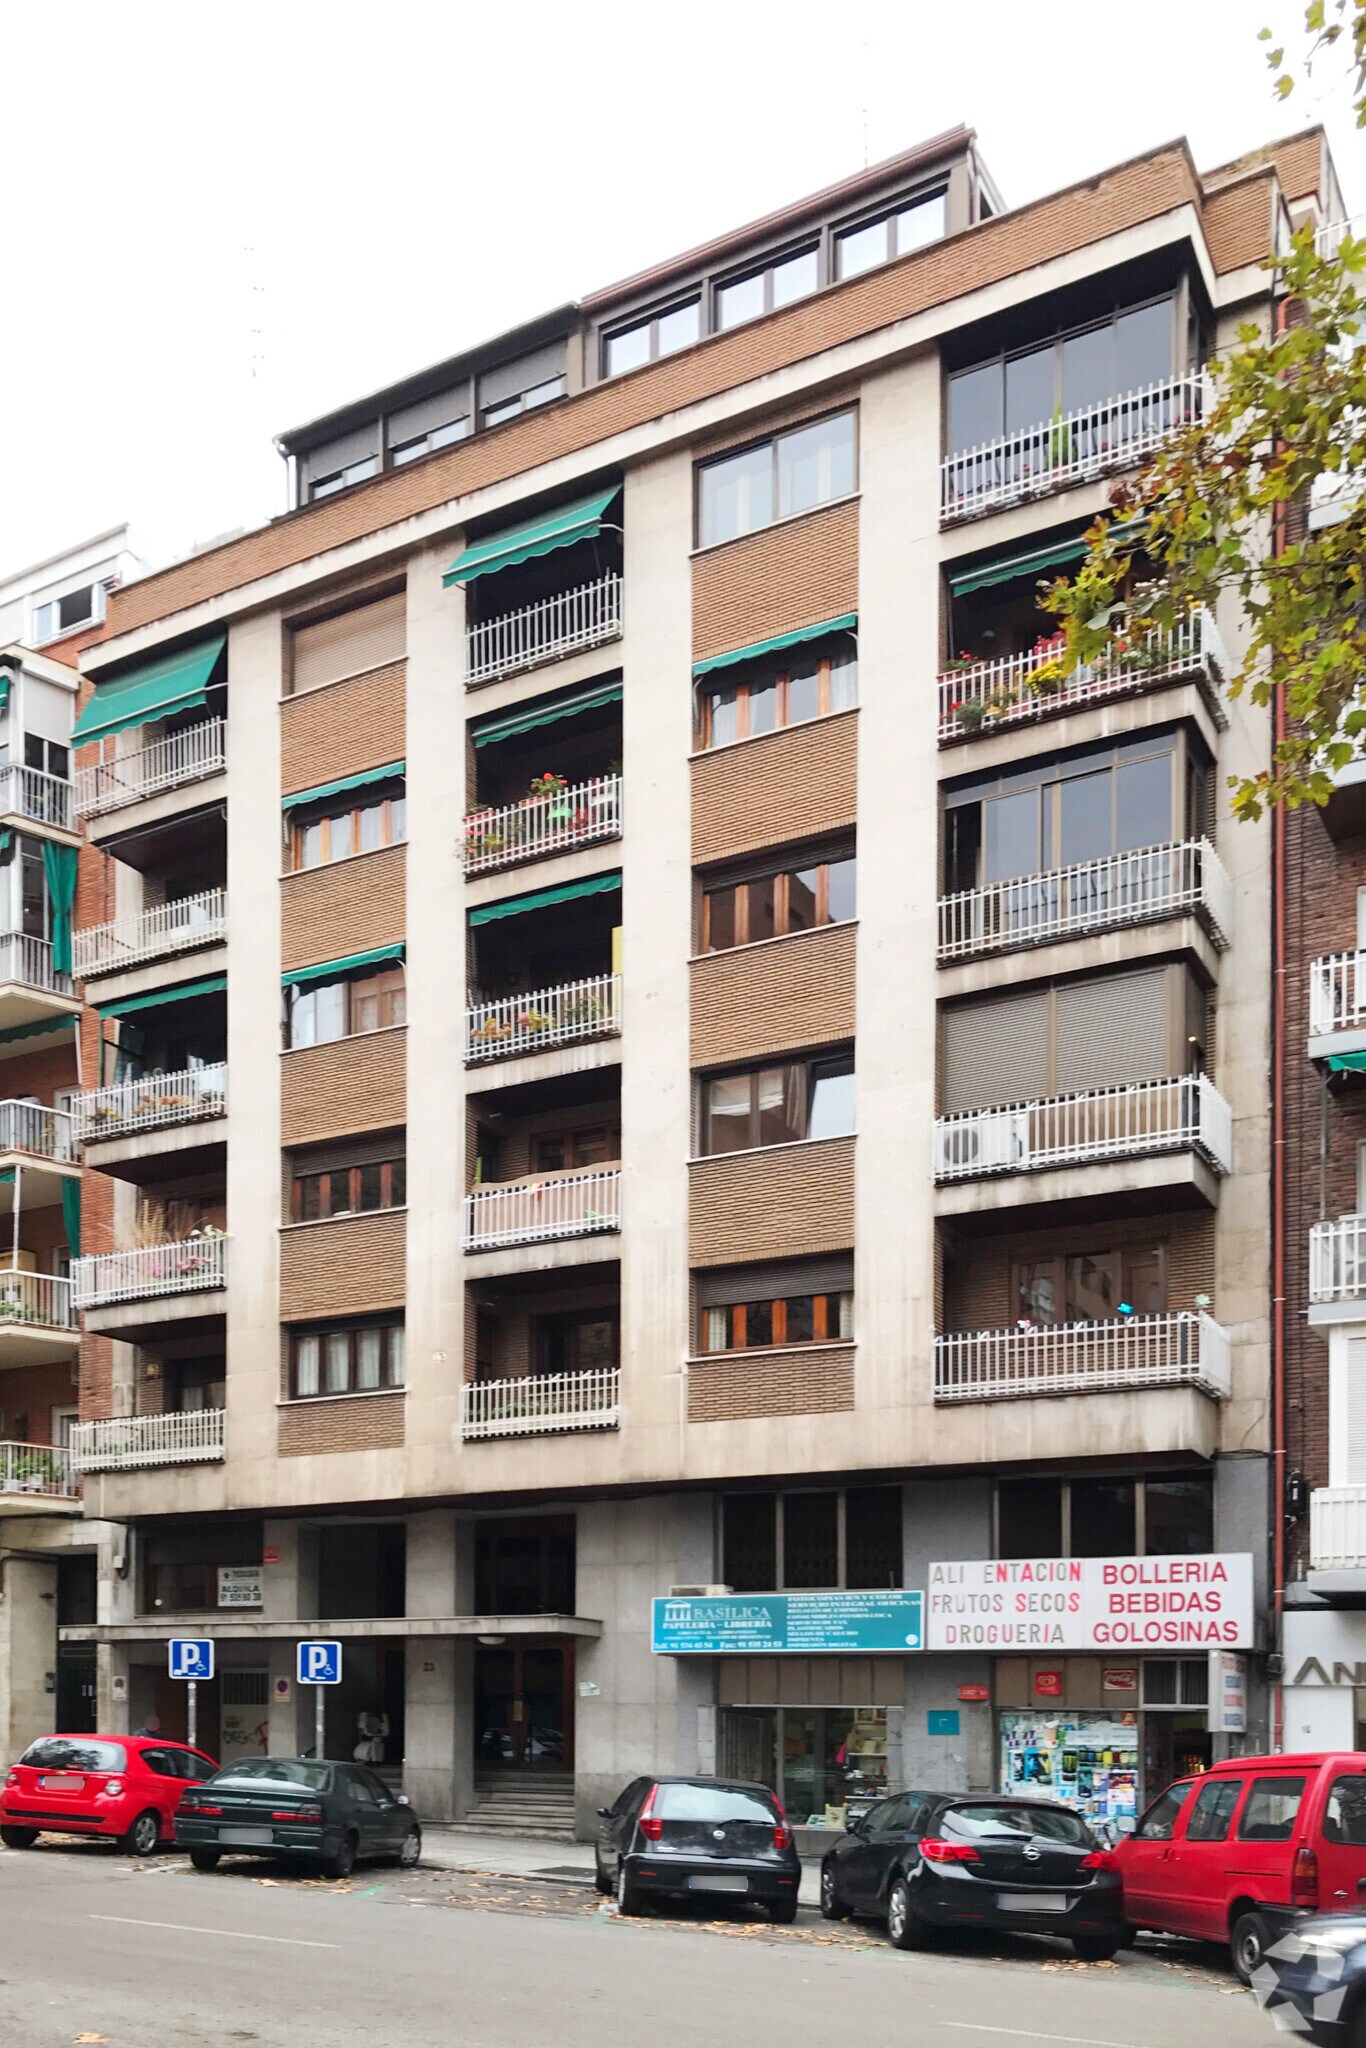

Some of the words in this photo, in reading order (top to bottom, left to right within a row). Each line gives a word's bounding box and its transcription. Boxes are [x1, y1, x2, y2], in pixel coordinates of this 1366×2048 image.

[1103, 1562, 1228, 1585] BOLLERIA
[693, 1605, 770, 1619] BASÍLICA
[931, 1593, 1004, 1613] FRUTOS
[1015, 1592, 1080, 1613] SECOS
[1109, 1591, 1222, 1614] BEBIDAS
[662, 1620, 716, 1629] PAPELERÍA
[724, 1619, 773, 1628] LIBRERÍA
[946, 1623, 1065, 1644] DROGUERIA
[1093, 1620, 1239, 1643] GOLOSINAS
[180, 1643, 200, 1673] P
[308, 1646, 328, 1678] P
[1293, 1656, 1366, 1684] AN
